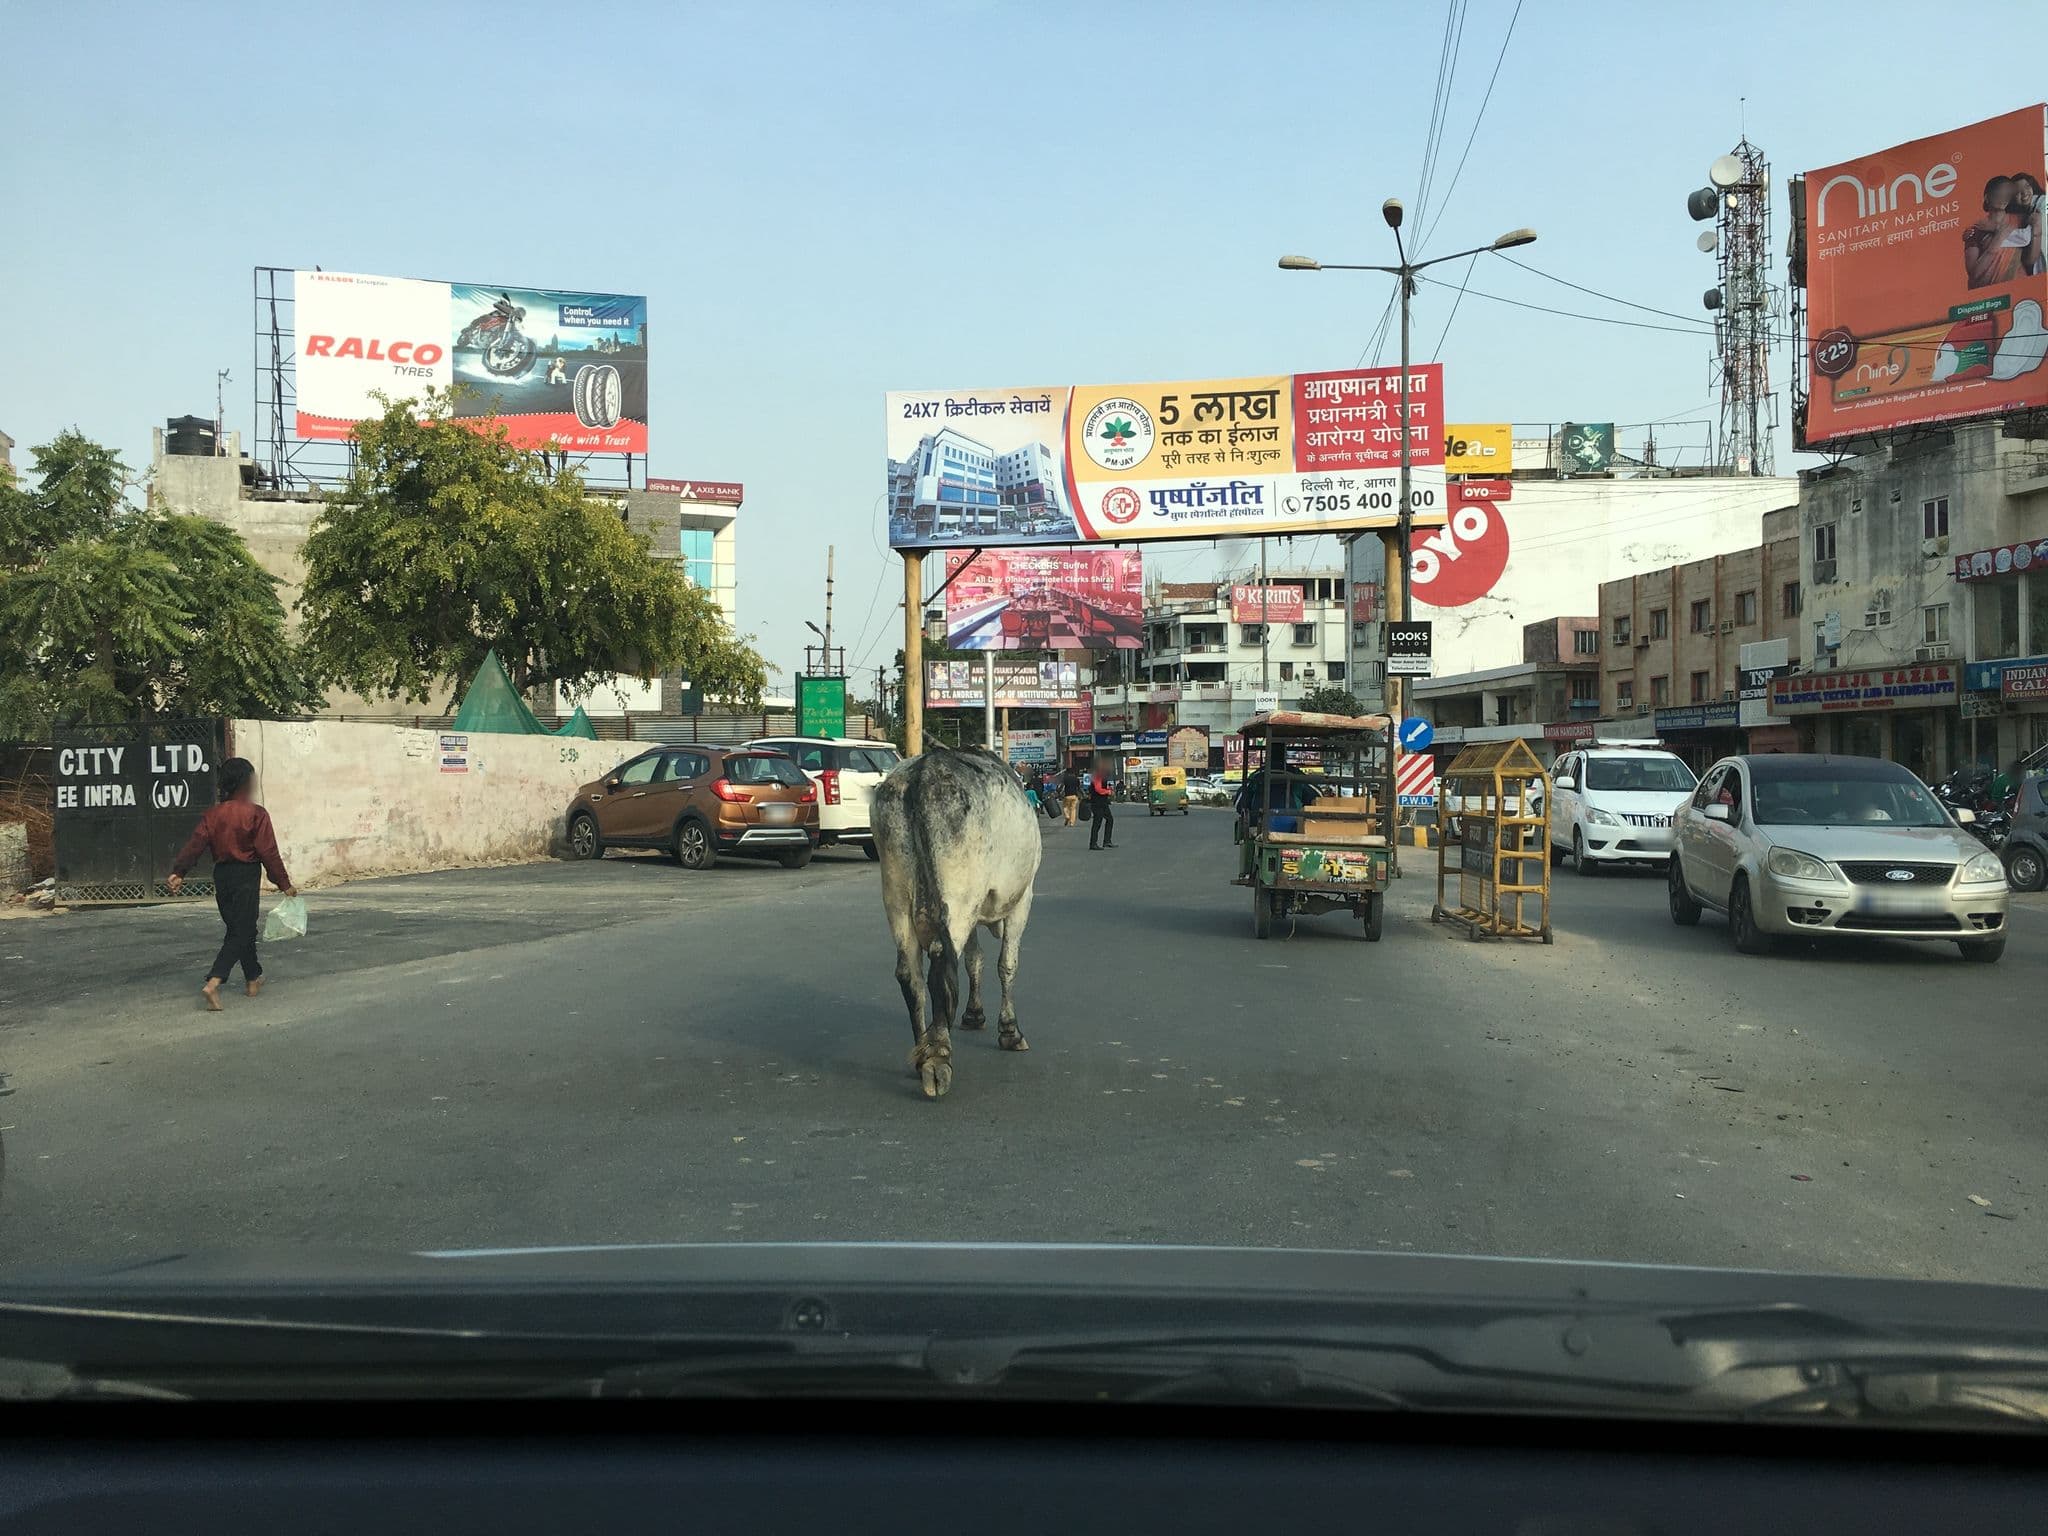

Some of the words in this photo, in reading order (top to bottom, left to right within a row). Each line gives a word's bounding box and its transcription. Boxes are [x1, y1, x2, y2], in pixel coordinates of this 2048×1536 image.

[1817, 163, 1958, 227] niine
[1818, 219, 1888, 244] SANITARY
[1895, 200, 1961, 227] NAPKINS
[1818, 243, 1846, 261] हमारी
[1887, 229, 1914, 246] हमारा
[1918, 217, 1961, 236] अधिकार
[1957, 303, 1985, 316] Disposal
[1986, 299, 2002, 310] Bags
[563, 316, 585, 325] when
[587, 318, 601, 327] you
[603, 317, 622, 326] need
[623, 318, 629, 326] it
[1971, 313, 1988, 323] FREE
[305, 334, 443, 366] RALCO
[393, 365, 434, 378] TYRES
[1857, 363, 1901, 382] niine
[1304, 377, 1382, 404] आयुष्मान
[1854, 397, 1884, 409] Available
[1893, 392, 1919, 404] Regular
[1927, 387, 1945, 398] Extra
[1946, 385, 1964, 395] Long
[903, 402, 940, 418] 24X7
[945, 397, 1006, 417] क्रिटीकल
[1009, 394, 1051, 414] सेवायें
[1159, 395, 1180, 425] 5
[1191, 389, 1280, 422] लाख
[1307, 399, 1388, 424] प्रधानमंत्री
[576, 433, 600, 445] with
[604, 434, 631, 446] Trust
[1161, 431, 1193, 446] तक
[1197, 429, 1222, 444] का
[1227, 422, 1280, 446] ईलाज
[1306, 426, 1365, 447] आरोग्य
[1445, 435, 1482, 457] dea
[1161, 450, 1181, 469] पूरी
[1186, 453, 1210, 464] तरह
[1214, 448, 1226, 462] से
[1306, 452, 1316, 463] के
[696, 486, 714, 494] AXIS
[717, 487, 740, 496] BANK
[1301, 477, 1334, 492] दिल्ली
[1364, 477, 1397, 488] आगरा
[1464, 487, 1489, 497] OYO
[1303, 494, 1351, 513] 7505
[1357, 492, 1393, 509] 400
[1170, 510, 1188, 521] सुपर
[1411, 506, 1488, 584] OYO
[1063, 562, 1089, 570] Buffet
[988, 576, 1002, 584] Day
[1005, 576, 1031, 584] Dining
[1041, 575, 1062, 583] Hotel
[1391, 632, 1428, 640] LOOKS
[1007, 675, 1038, 686] PROUD
[2006, 667, 2047, 680] INDIAN
[952, 690, 983, 699] ANDREWS
[1061, 690, 1078, 699] AGRA
[59, 747, 125, 776] CITY
[150, 744, 210, 773] LTD.
[57, 785, 78, 808] EE
[84, 784, 136, 807] INFRA
[152, 778, 190, 809] (JV)
[1401, 796, 1430, 805] P.W.D.
